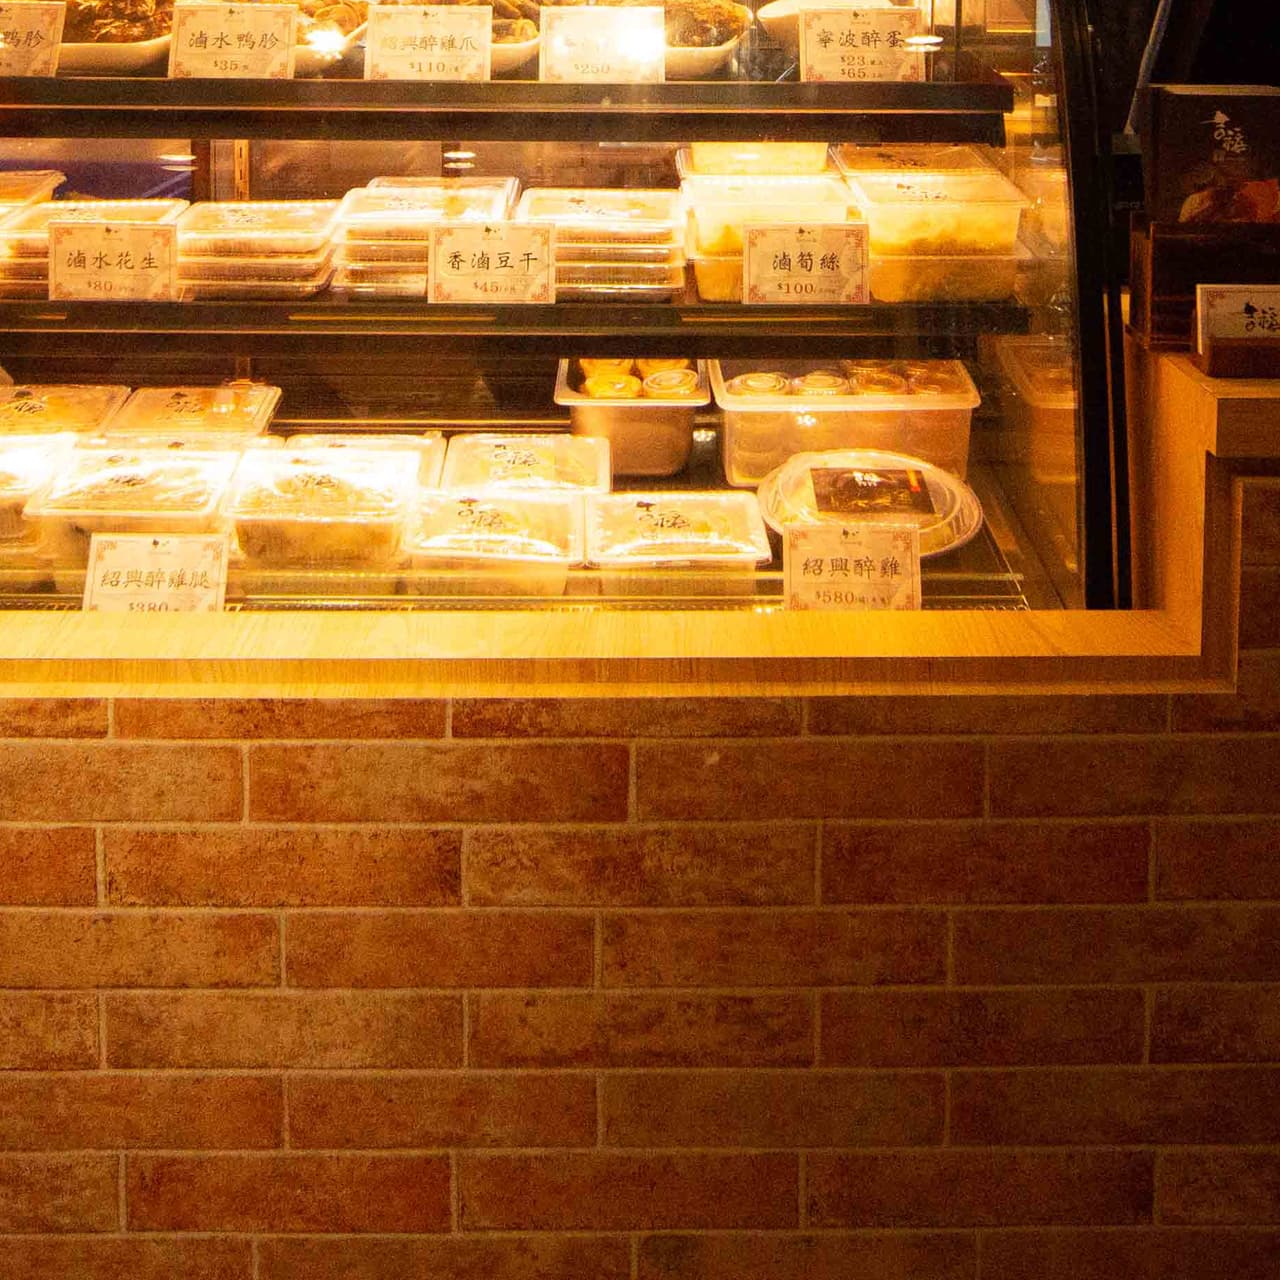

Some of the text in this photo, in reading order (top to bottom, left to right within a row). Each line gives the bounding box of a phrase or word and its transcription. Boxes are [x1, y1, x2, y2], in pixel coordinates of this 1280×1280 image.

[188, 30, 279, 50] 滷水鴨胗
[67, 250, 159, 270] 滷水花生
[447, 250, 539, 272] 香滷豆干
[772, 251, 840, 272] 滷筍絲
[802, 555, 903, 579] 紹興醉雞
